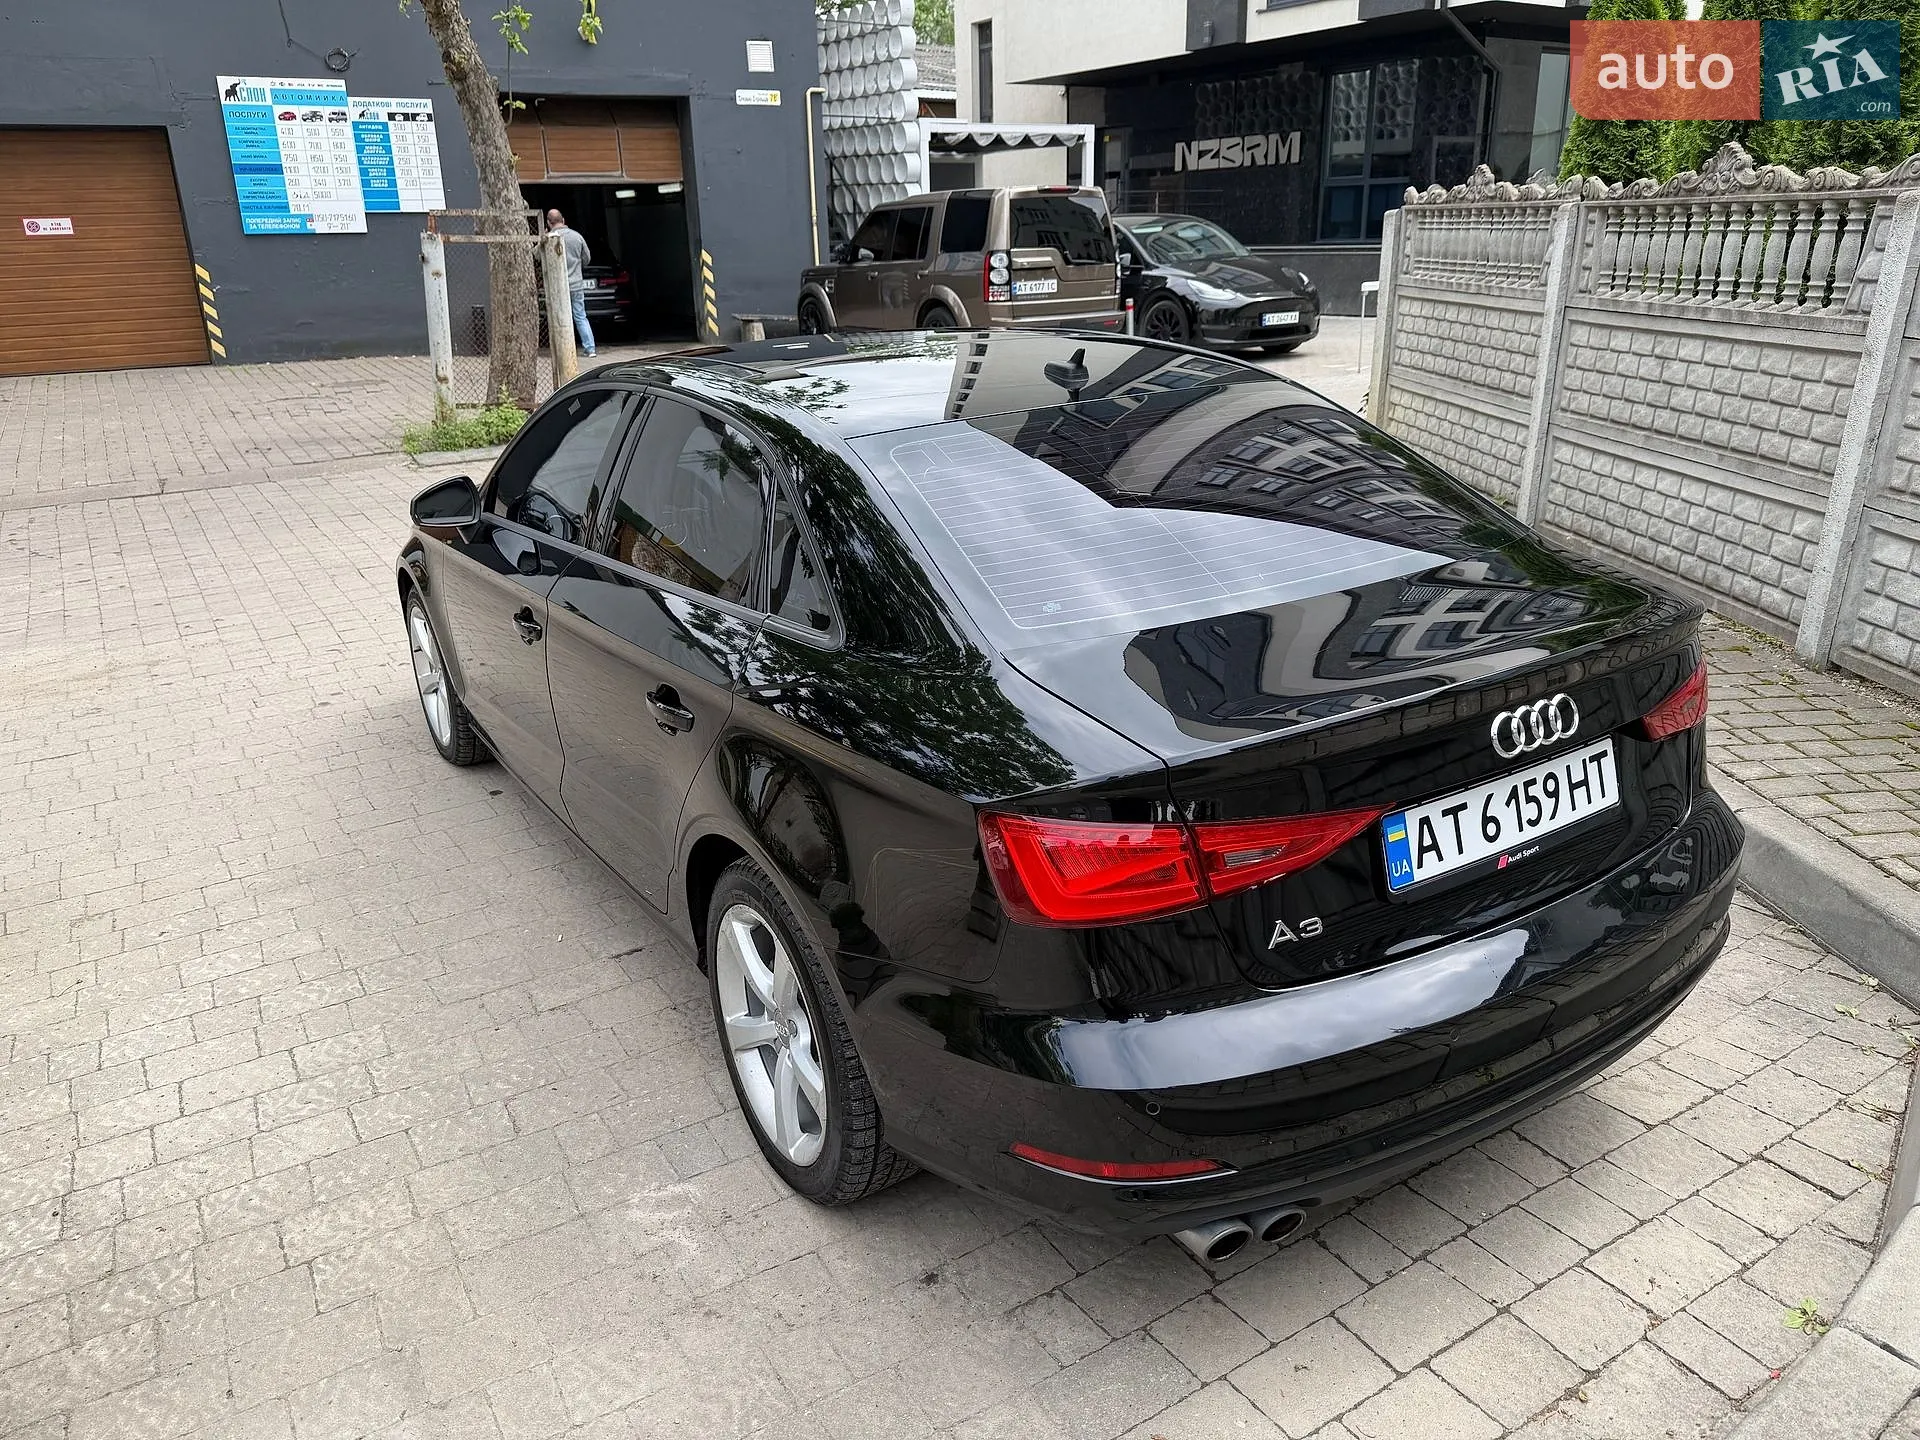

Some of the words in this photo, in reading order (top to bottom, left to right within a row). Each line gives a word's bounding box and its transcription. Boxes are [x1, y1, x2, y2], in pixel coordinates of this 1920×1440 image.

[228, 110, 268, 118] ПОСЛУГИ
[1017, 284, 1029, 293] AT
[1029, 283, 1044, 292] 6177
[1416, 801, 1469, 870] AT
[1481, 771, 1560, 844] 6159
[1566, 749, 1609, 812] HT
[1507, 850, 1523, 864] Audi
[1523, 845, 1540, 858] Sport
[1391, 858, 1411, 878] UA
[1267, 916, 1324, 950] A3
